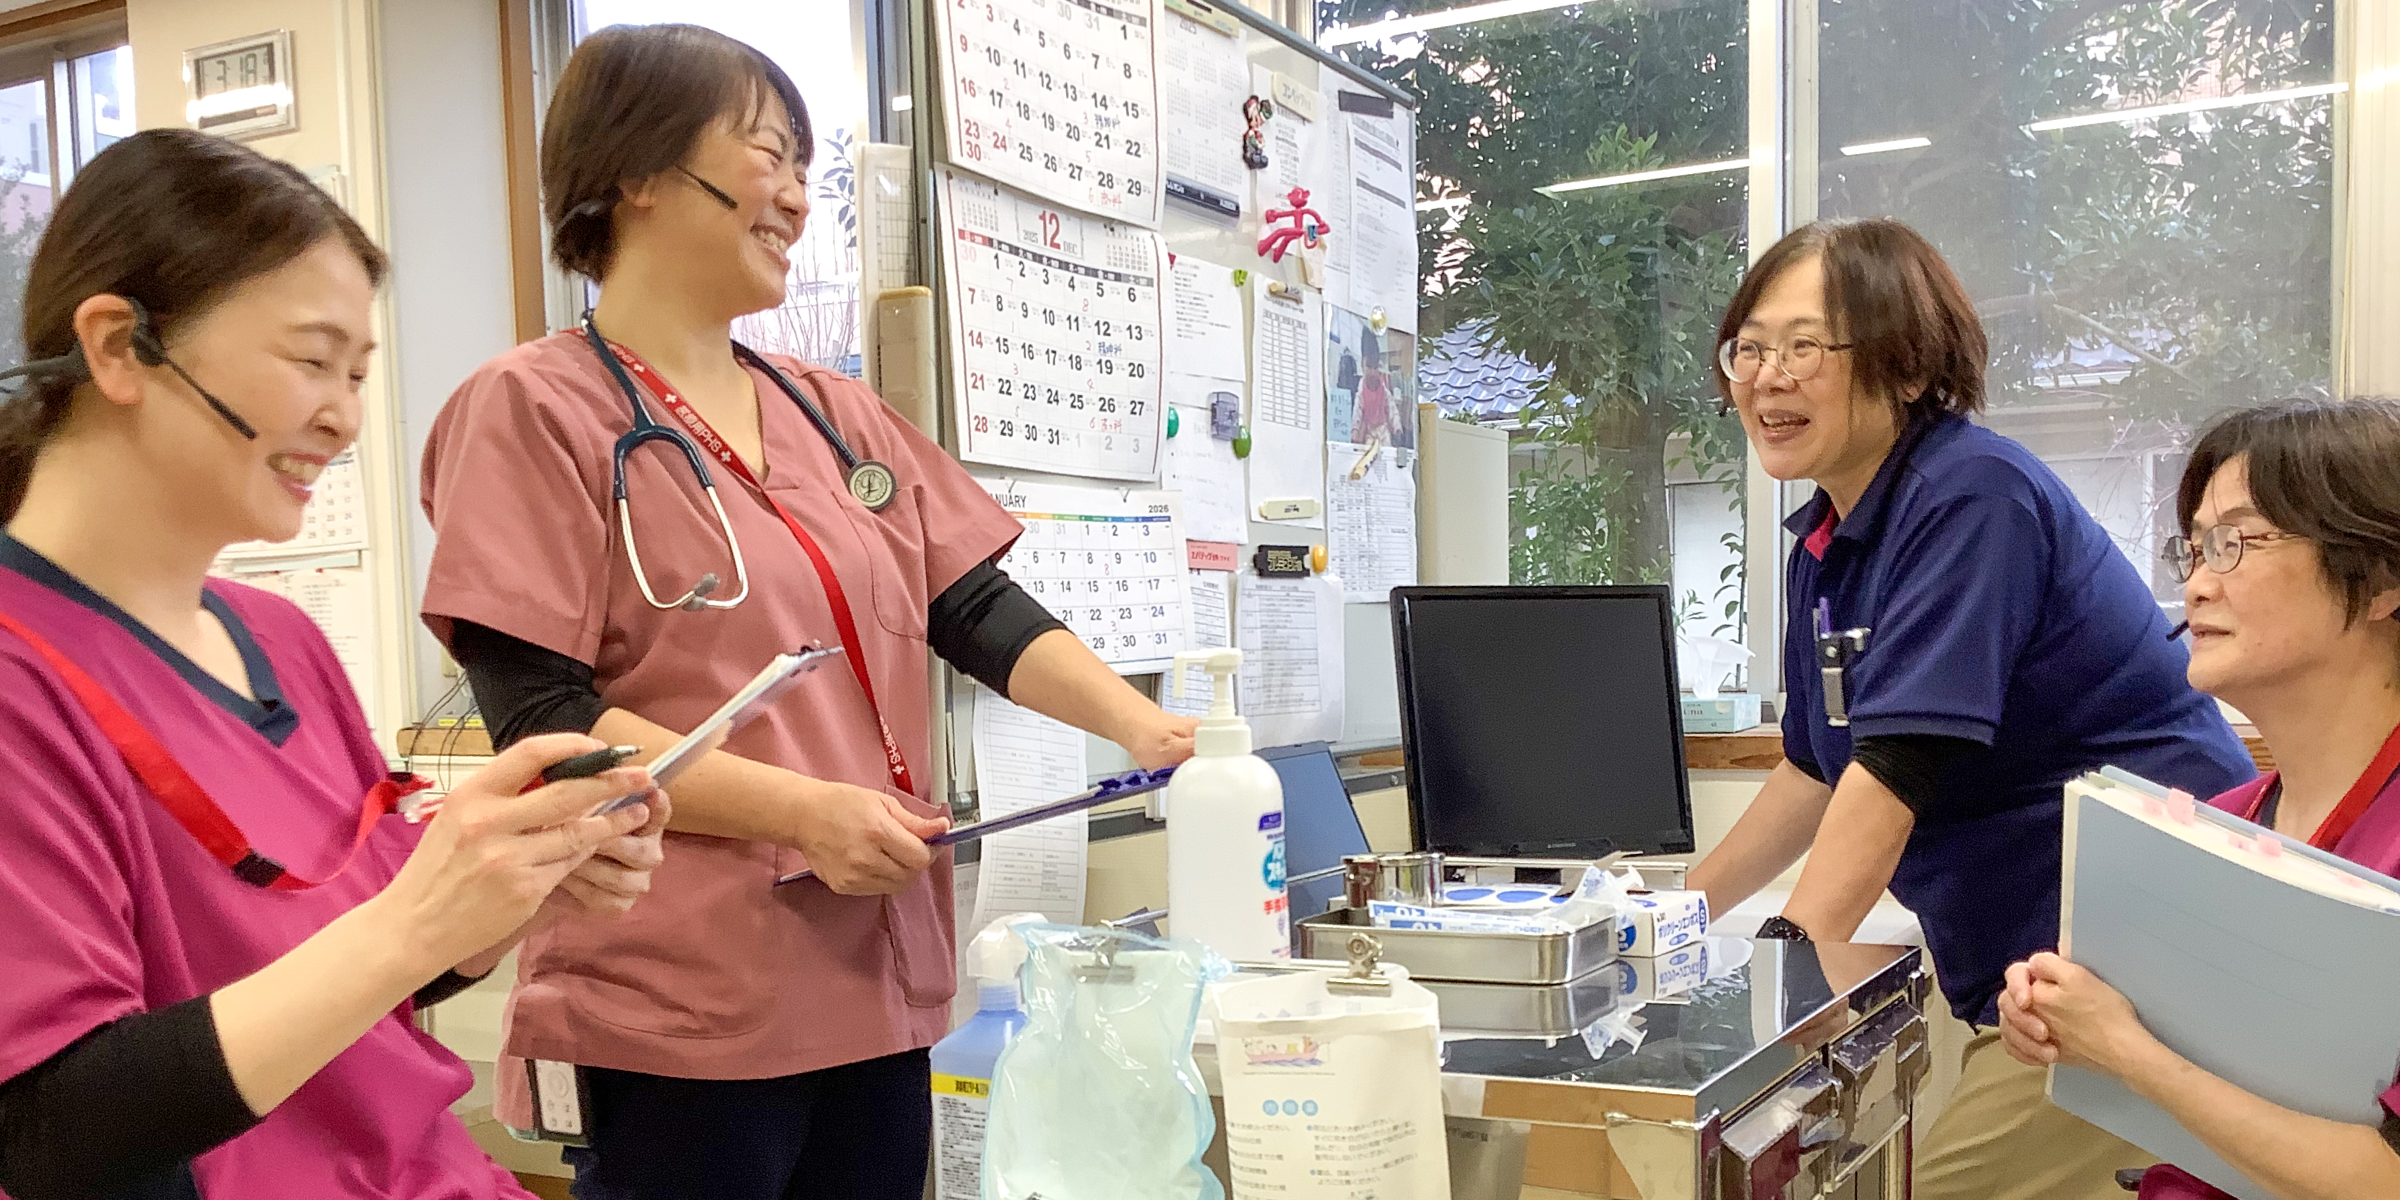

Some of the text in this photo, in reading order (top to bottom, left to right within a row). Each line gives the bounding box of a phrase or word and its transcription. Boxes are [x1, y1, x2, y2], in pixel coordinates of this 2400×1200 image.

[987, 4, 993, 22] 3
[1014, 19, 1020, 36] 4
[1039, 30, 1045, 48] 5
[1064, 43, 1071, 60] 6
[1092, 54, 1099, 69] 7
[1124, 63, 1131, 79] 8
[1121, 24, 1127, 40] 1
[960, 34, 1139, 118] 9 10 11 12 13 14 15
[961, 78, 1141, 158] 16 17 18 19 20 21 22
[965, 119, 1141, 196] 23 24 25 26 27 28 29
[966, 141, 981, 160] 30
[1038, 210, 1061, 250] 12
[1063, 240, 1078, 256] DEC
[994, 253, 1000, 270] 1
[1018, 261, 1026, 278] 2
[1043, 268, 1049, 285] 3
[1068, 275, 1075, 291] 4
[1096, 282, 1104, 297] 5
[1128, 287, 1136, 303] 6
[969, 288, 1143, 340] 7 8 9 10 11 12 13
[969, 330, 1144, 378] 14 15 16 17 18 19 20
[971, 373, 1144, 416] 21 22 23 24 25 26 27
[974, 415, 988, 433] 28
[1000, 420, 1013, 438] 29
[1025, 425, 1037, 442] 30
[1048, 429, 1060, 445] 31
[1105, 435, 1113, 451] 2
[1133, 438, 1139, 453] 3
[1029, 522, 1149, 536] 30 31 1 2 3
[1149, 505, 1169, 513] 2026
[1033, 551, 1038, 564] 6
[1060, 552, 1066, 564] 7
[1087, 553, 1093, 564] 8
[1115, 553, 1121, 564] 9
[1143, 552, 1156, 563] 10
[1034, 579, 1159, 593] 13 14 15 16 17
[1063, 606, 1164, 621] 21 22 23 24
[1093, 633, 1167, 649] 29 30 31
